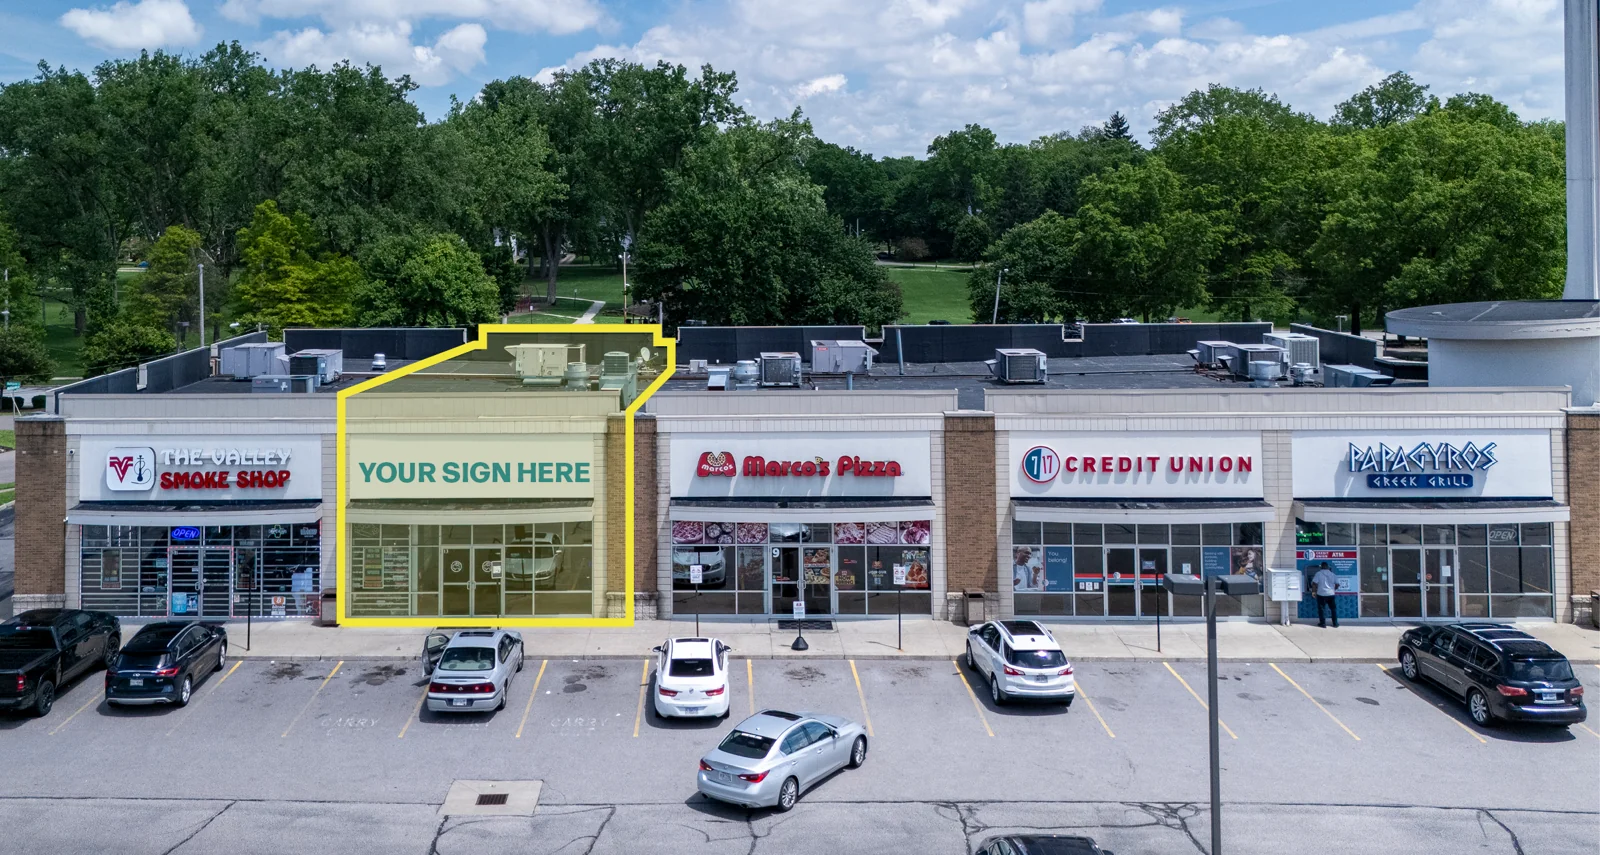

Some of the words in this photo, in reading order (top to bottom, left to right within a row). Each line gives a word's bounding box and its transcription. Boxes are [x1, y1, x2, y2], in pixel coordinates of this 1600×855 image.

[160, 449, 203, 466] THE
[211, 449, 292, 465] VALLEY
[743, 455, 831, 476] Marco's
[838, 455, 901, 476] Pizza
[1065, 456, 1161, 473] CREDIT
[1170, 456, 1253, 473] UNION
[1349, 442, 1498, 472] PAPAGYROS
[160, 471, 230, 489] SMOKE
[236, 470, 291, 488] SHOP
[1373, 475, 1417, 487] GREEK
[1428, 475, 1469, 487] GRILL
[173, 527, 197, 539] OPEN
[1489, 530, 1514, 540] OPEN
[772, 548, 780, 558] 9
